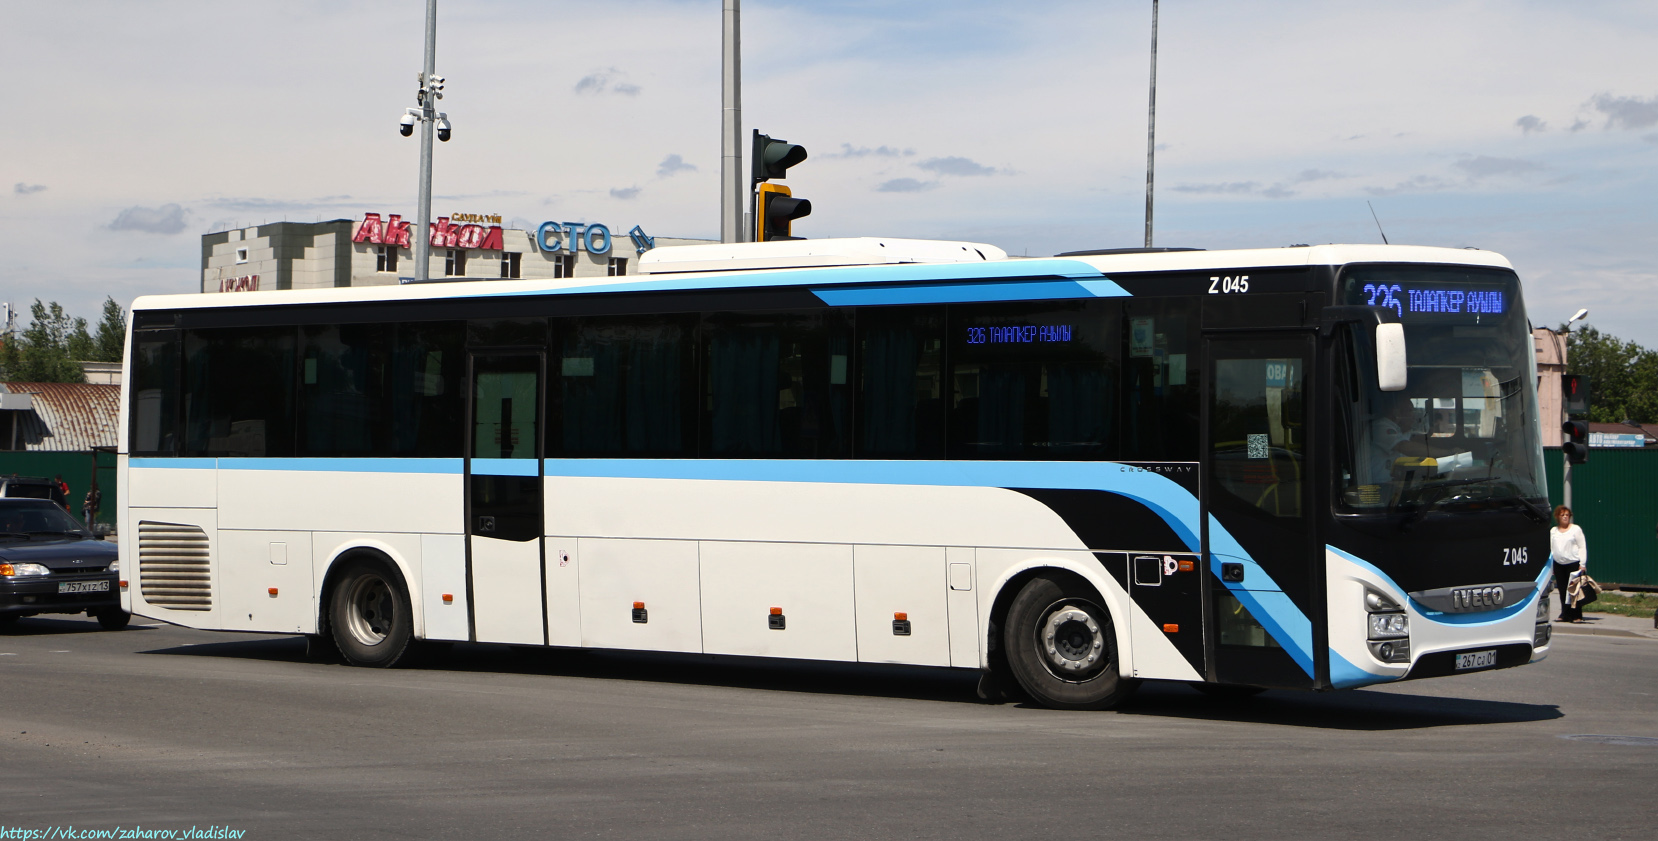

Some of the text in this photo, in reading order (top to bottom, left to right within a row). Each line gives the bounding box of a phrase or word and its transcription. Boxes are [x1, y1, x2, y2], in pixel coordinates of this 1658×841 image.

[537, 221, 611, 255] СТО
[1208, 275, 1249, 294] Z 045
[1408, 289, 1465, 313] ТАЛАПКЕР
[1466, 291, 1502, 313] АУЫЛЫ
[967, 325, 1071, 344] 326 ТАЛАПКЕР АУЫЛЫ
[1503, 546, 1528, 566] Z 045
[66, 583, 82, 592] 757
[99, 581, 109, 590] 13
[1453, 587, 1504, 609] IVECO
[1462, 654, 1476, 668] 267
[1487, 651, 1496, 664] 01
